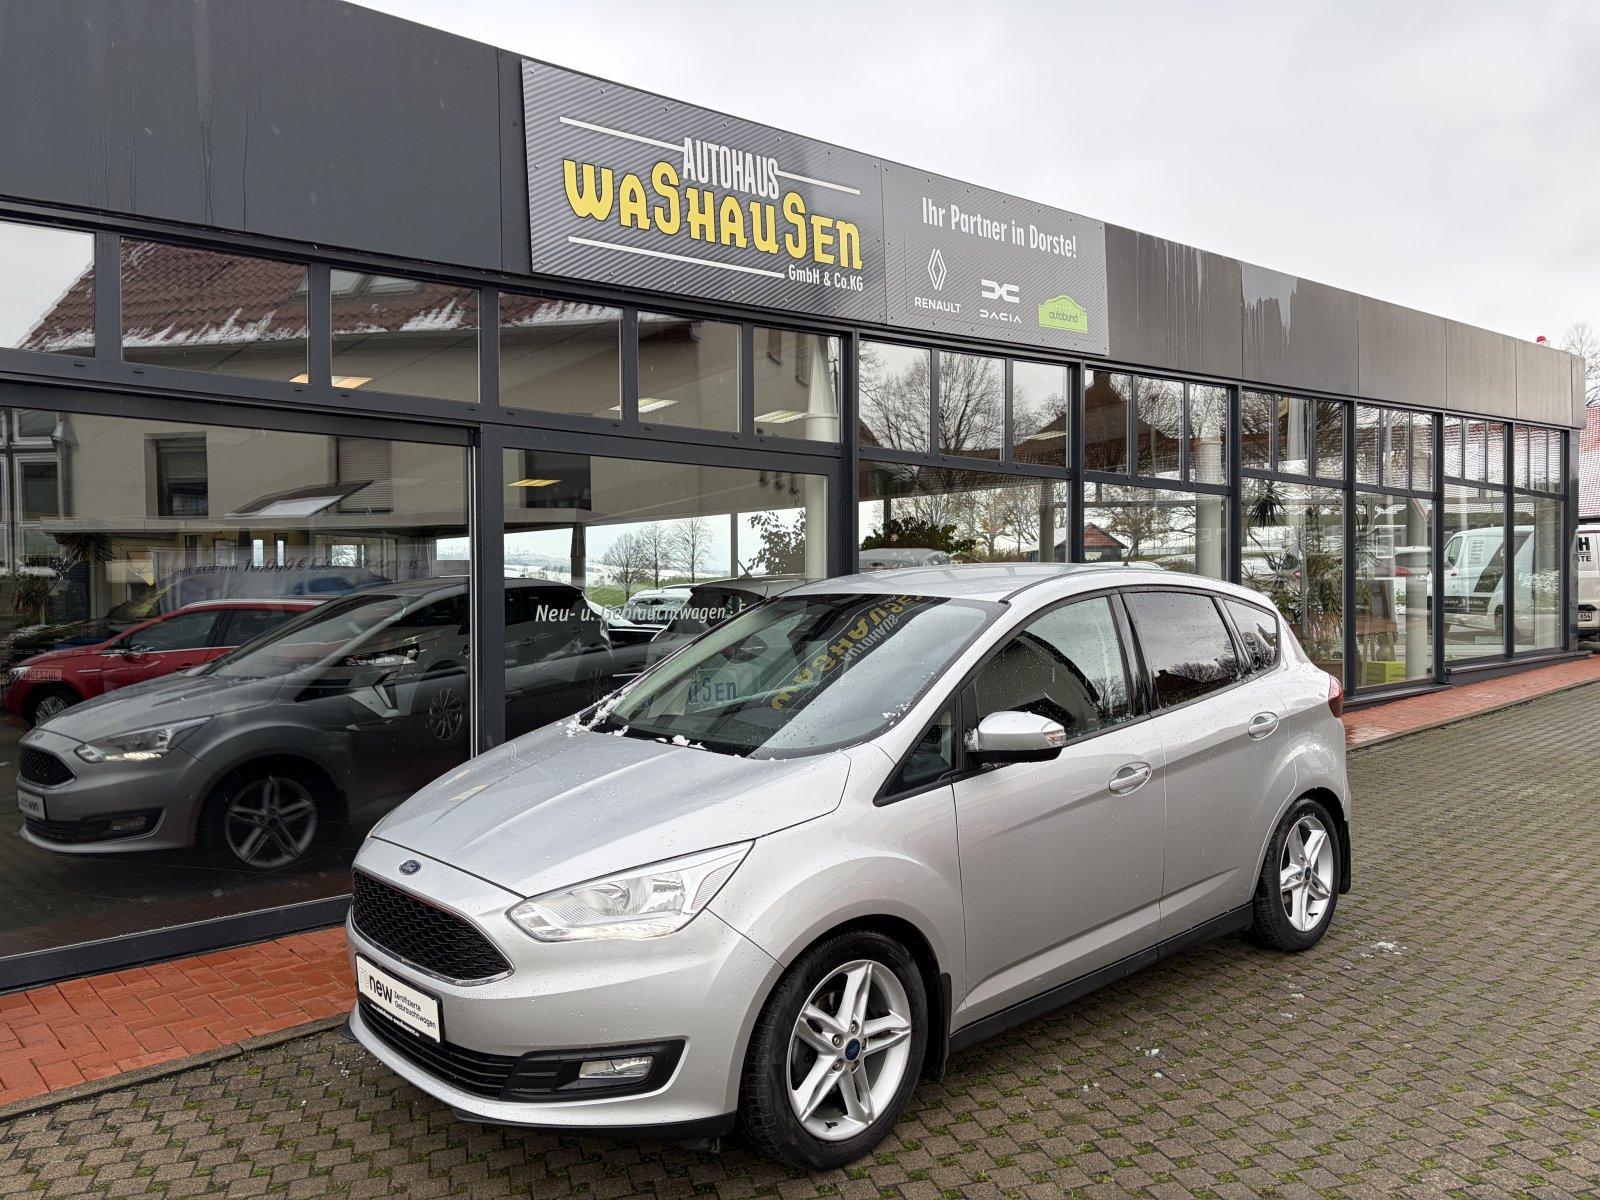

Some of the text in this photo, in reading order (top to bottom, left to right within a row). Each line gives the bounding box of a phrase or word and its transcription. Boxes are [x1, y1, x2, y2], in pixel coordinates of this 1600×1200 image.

[682, 137, 779, 199] AUTOHAUS
[923, 197, 1077, 258] Ihr Partner in Dorste!
[788, 264, 864, 292] GmbH & Co.KG
[914, 297, 961, 314] RENAULT
[979, 309, 1023, 324] DACIA
[535, 604, 576, 622] Neu-
[581, 608, 595, 622] u.
[602, 604, 726, 624] Gebrauchtwagen
